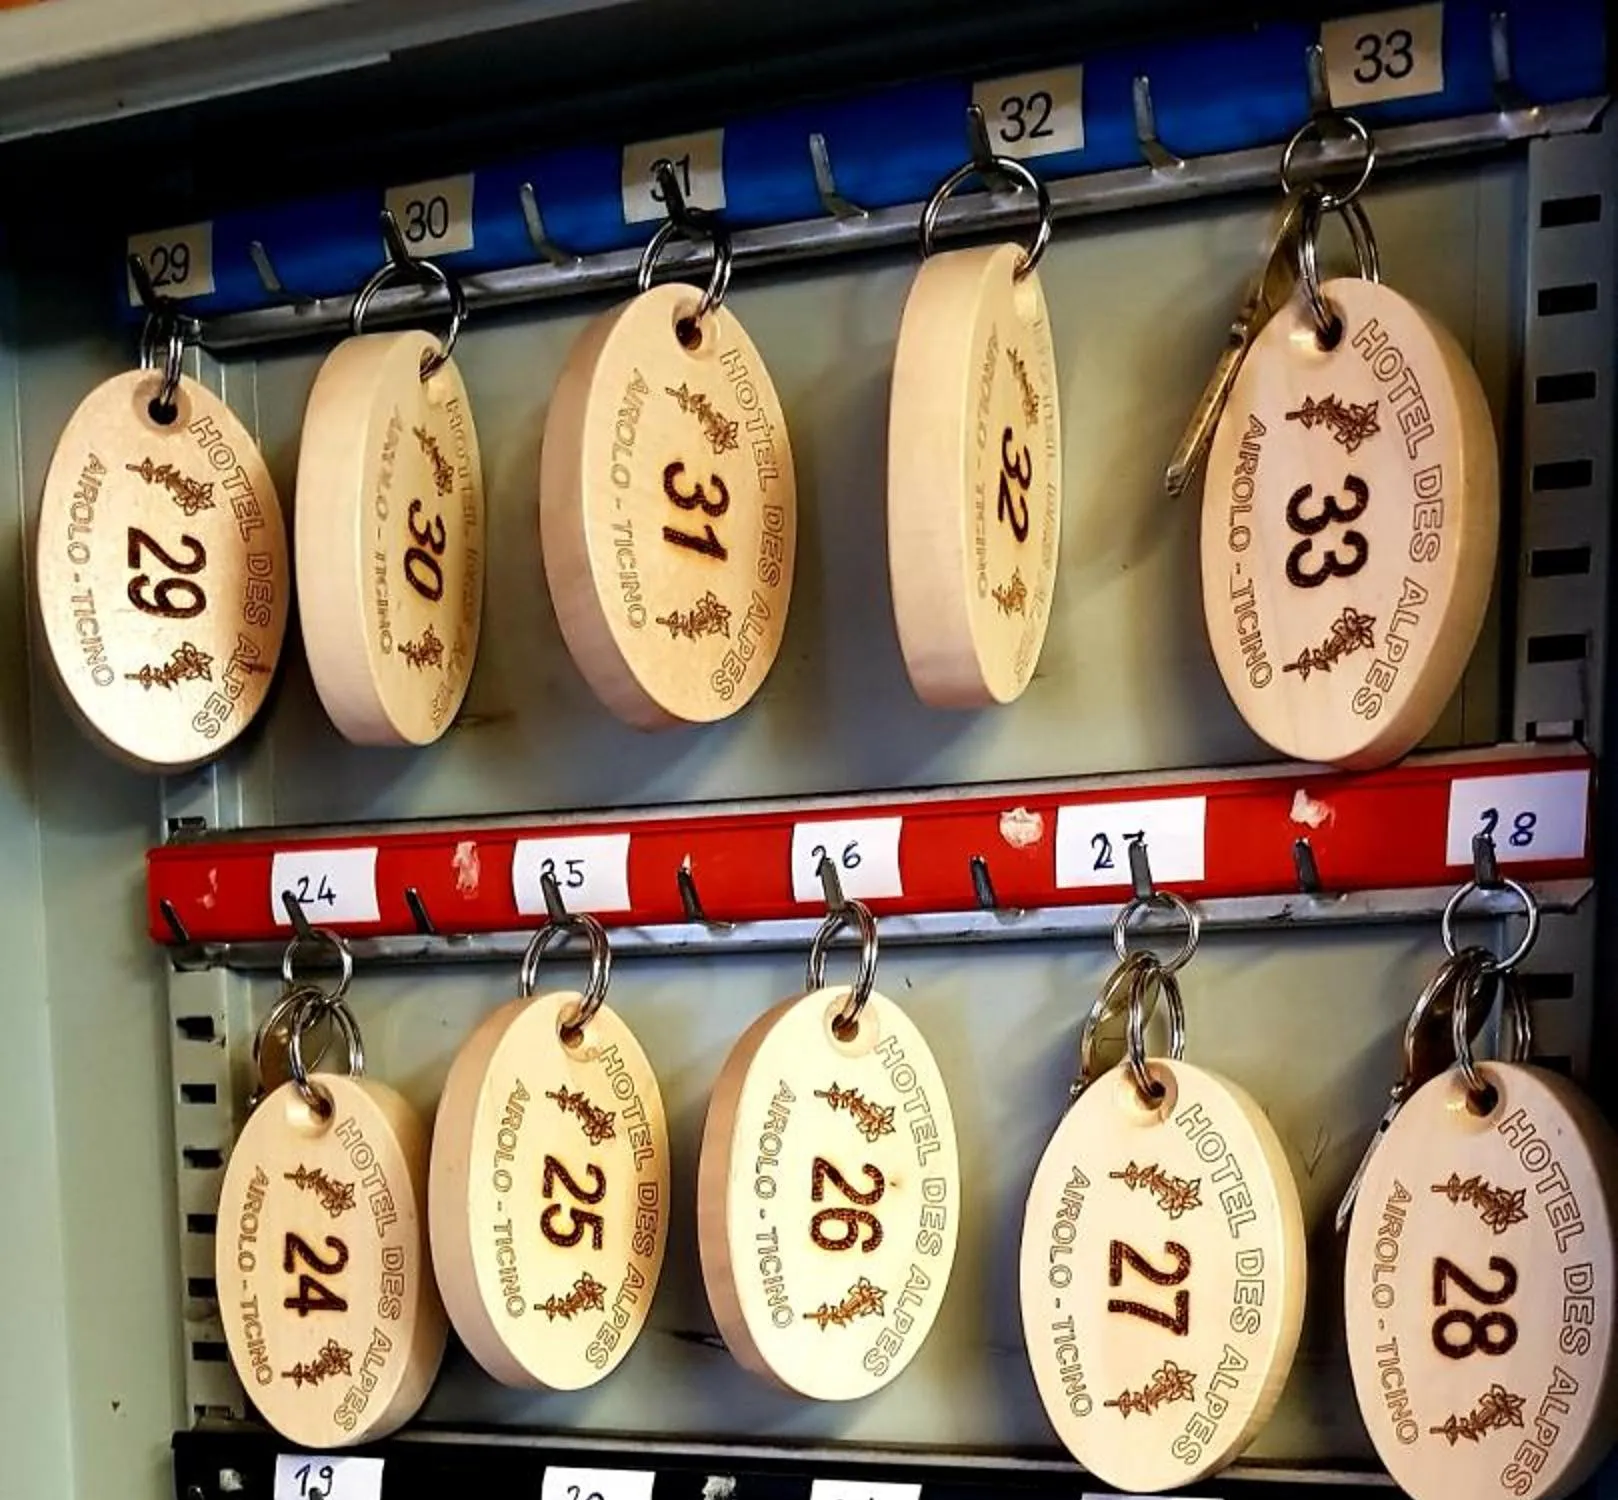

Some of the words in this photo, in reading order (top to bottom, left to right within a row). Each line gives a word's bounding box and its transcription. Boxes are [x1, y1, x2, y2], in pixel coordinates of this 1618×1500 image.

[1354, 29, 1414, 84] 33
[1000, 92, 1054, 143] 32
[150, 243, 190, 286] 29
[404, 197, 448, 243] 30
[611, 368, 649, 489] AIROLO
[720, 349, 779, 492] HOTEL
[1352, 318, 1435, 458] HOTEL
[66, 453, 107, 564] AIROLO
[190, 416, 263, 542] HOTEL
[662, 461, 730, 562] 31
[997, 426, 1032, 543] 32
[1229, 413, 1267, 553] AIROLO
[1285, 474, 1369, 589] 33
[1409, 464, 1443, 564] DES
[128, 527, 207, 619] 29
[244, 553, 274, 628] DES
[404, 498, 446, 602] 30
[611, 518, 647, 630] TICINO
[757, 504, 784, 588] DES
[70, 587, 115, 687] TICINO
[711, 590, 771, 700] ALPES
[1229, 575, 1273, 689] TICINO
[1353, 577, 1428, 720] ALPES
[193, 633, 273, 739] ALPES
[812, 840, 861, 877] 26
[1480, 808, 1537, 847] 28
[297, 875, 337, 904] 24
[494, 1079, 531, 1193] AIROLO
[600, 1044, 654, 1171] HOTEL
[755, 1079, 796, 1200] AIROLO
[874, 1035, 941, 1166] HOTEL
[238, 1165, 269, 1273] AIROLO
[335, 1117, 399, 1238] HOTEL
[540, 1154, 606, 1251] 25
[632, 1182, 658, 1257] DES
[810, 1156, 885, 1253] 26
[916, 1177, 947, 1258] DES
[1175, 1103, 1254, 1238] HOTEL
[1498, 1109, 1585, 1252] HOTEL
[283, 1232, 349, 1317] 24
[493, 1219, 527, 1318] TICINO
[755, 1226, 795, 1329] TICINO
[1049, 1165, 1092, 1289] AIROLO
[1371, 1180, 1413, 1308] AIROLO
[379, 1246, 404, 1321] DES
[586, 1262, 644, 1369] ALPES
[864, 1264, 931, 1377] ALPES
[1108, 1240, 1191, 1337] 27
[1230, 1248, 1264, 1335] DES
[1430, 1255, 1518, 1360] 28
[1559, 1264, 1595, 1356] DES
[239, 1295, 274, 1386] TICINO
[334, 1327, 393, 1432] ALPES
[1054, 1315, 1092, 1418] TICINO
[1376, 1337, 1419, 1445] TICINO
[1172, 1344, 1248, 1465] ALPES
[1501, 1367, 1578, 1496] ALPES
[294, 1463, 333, 1496] 19
